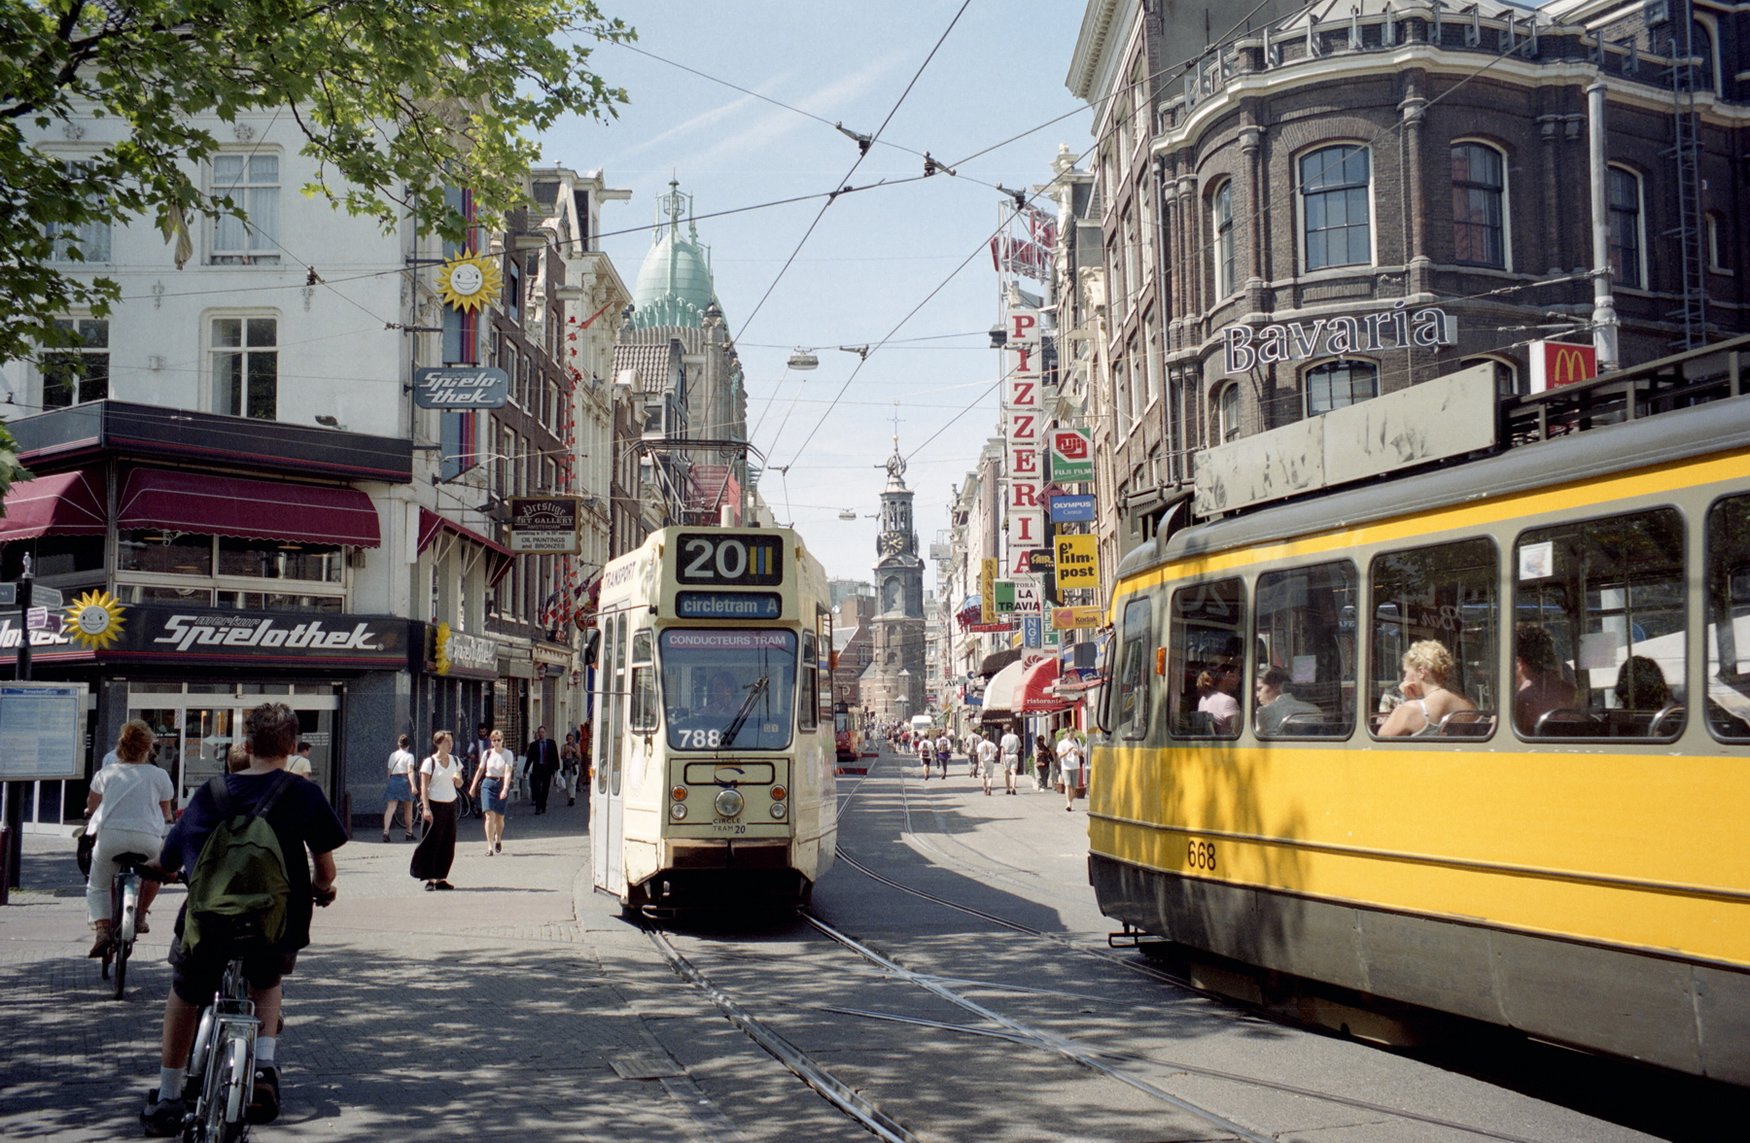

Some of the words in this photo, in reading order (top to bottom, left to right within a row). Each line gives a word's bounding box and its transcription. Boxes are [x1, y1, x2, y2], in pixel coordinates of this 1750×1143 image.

[1222, 300, 1450, 376] Bavaria
[425, 388, 496, 404] thek
[1010, 314, 1037, 574] PIZZERIA
[523, 502, 566, 517] Prestige
[1053, 501, 1091, 509] OLYMPUS
[534, 516, 573, 524] GALLERY
[684, 539, 747, 579] 20
[1061, 567, 1095, 580] post
[1018, 590, 1033, 598] LA
[683, 598, 758, 613] circletram
[766, 599, 778, 613] A
[195, 615, 261, 626] merkur
[1075, 616, 1097, 625] Kodak
[153, 615, 377, 650] Spielothek
[669, 635, 750, 646] CONDUCTEURS
[753, 635, 786, 645] TRAM
[678, 729, 721, 748] 788
[735, 825, 746, 833] 20
[1188, 840, 1216, 871] 668
